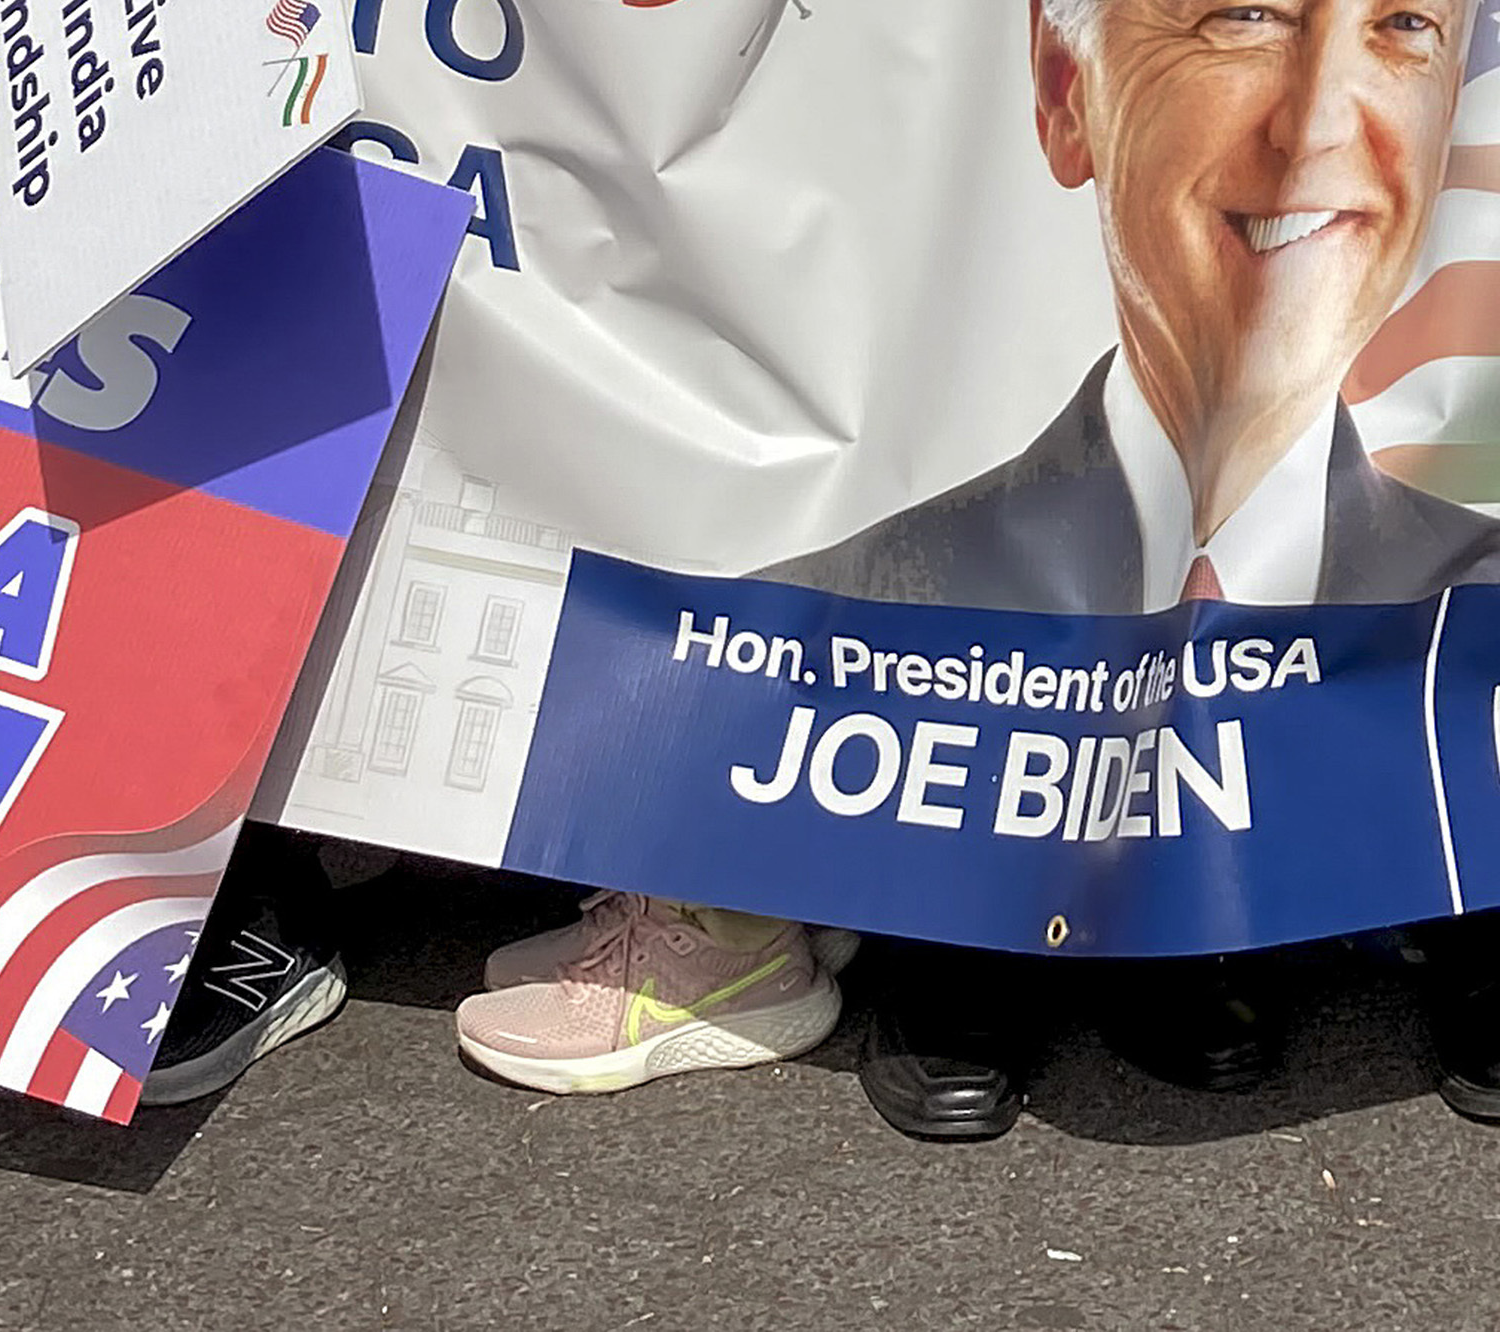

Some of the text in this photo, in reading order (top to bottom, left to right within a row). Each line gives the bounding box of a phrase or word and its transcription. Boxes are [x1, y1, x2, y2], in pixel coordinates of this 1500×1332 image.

[672, 610, 1322, 712] Hon. President of the USA
[729, 706, 1252, 843] JOE BIDEN
